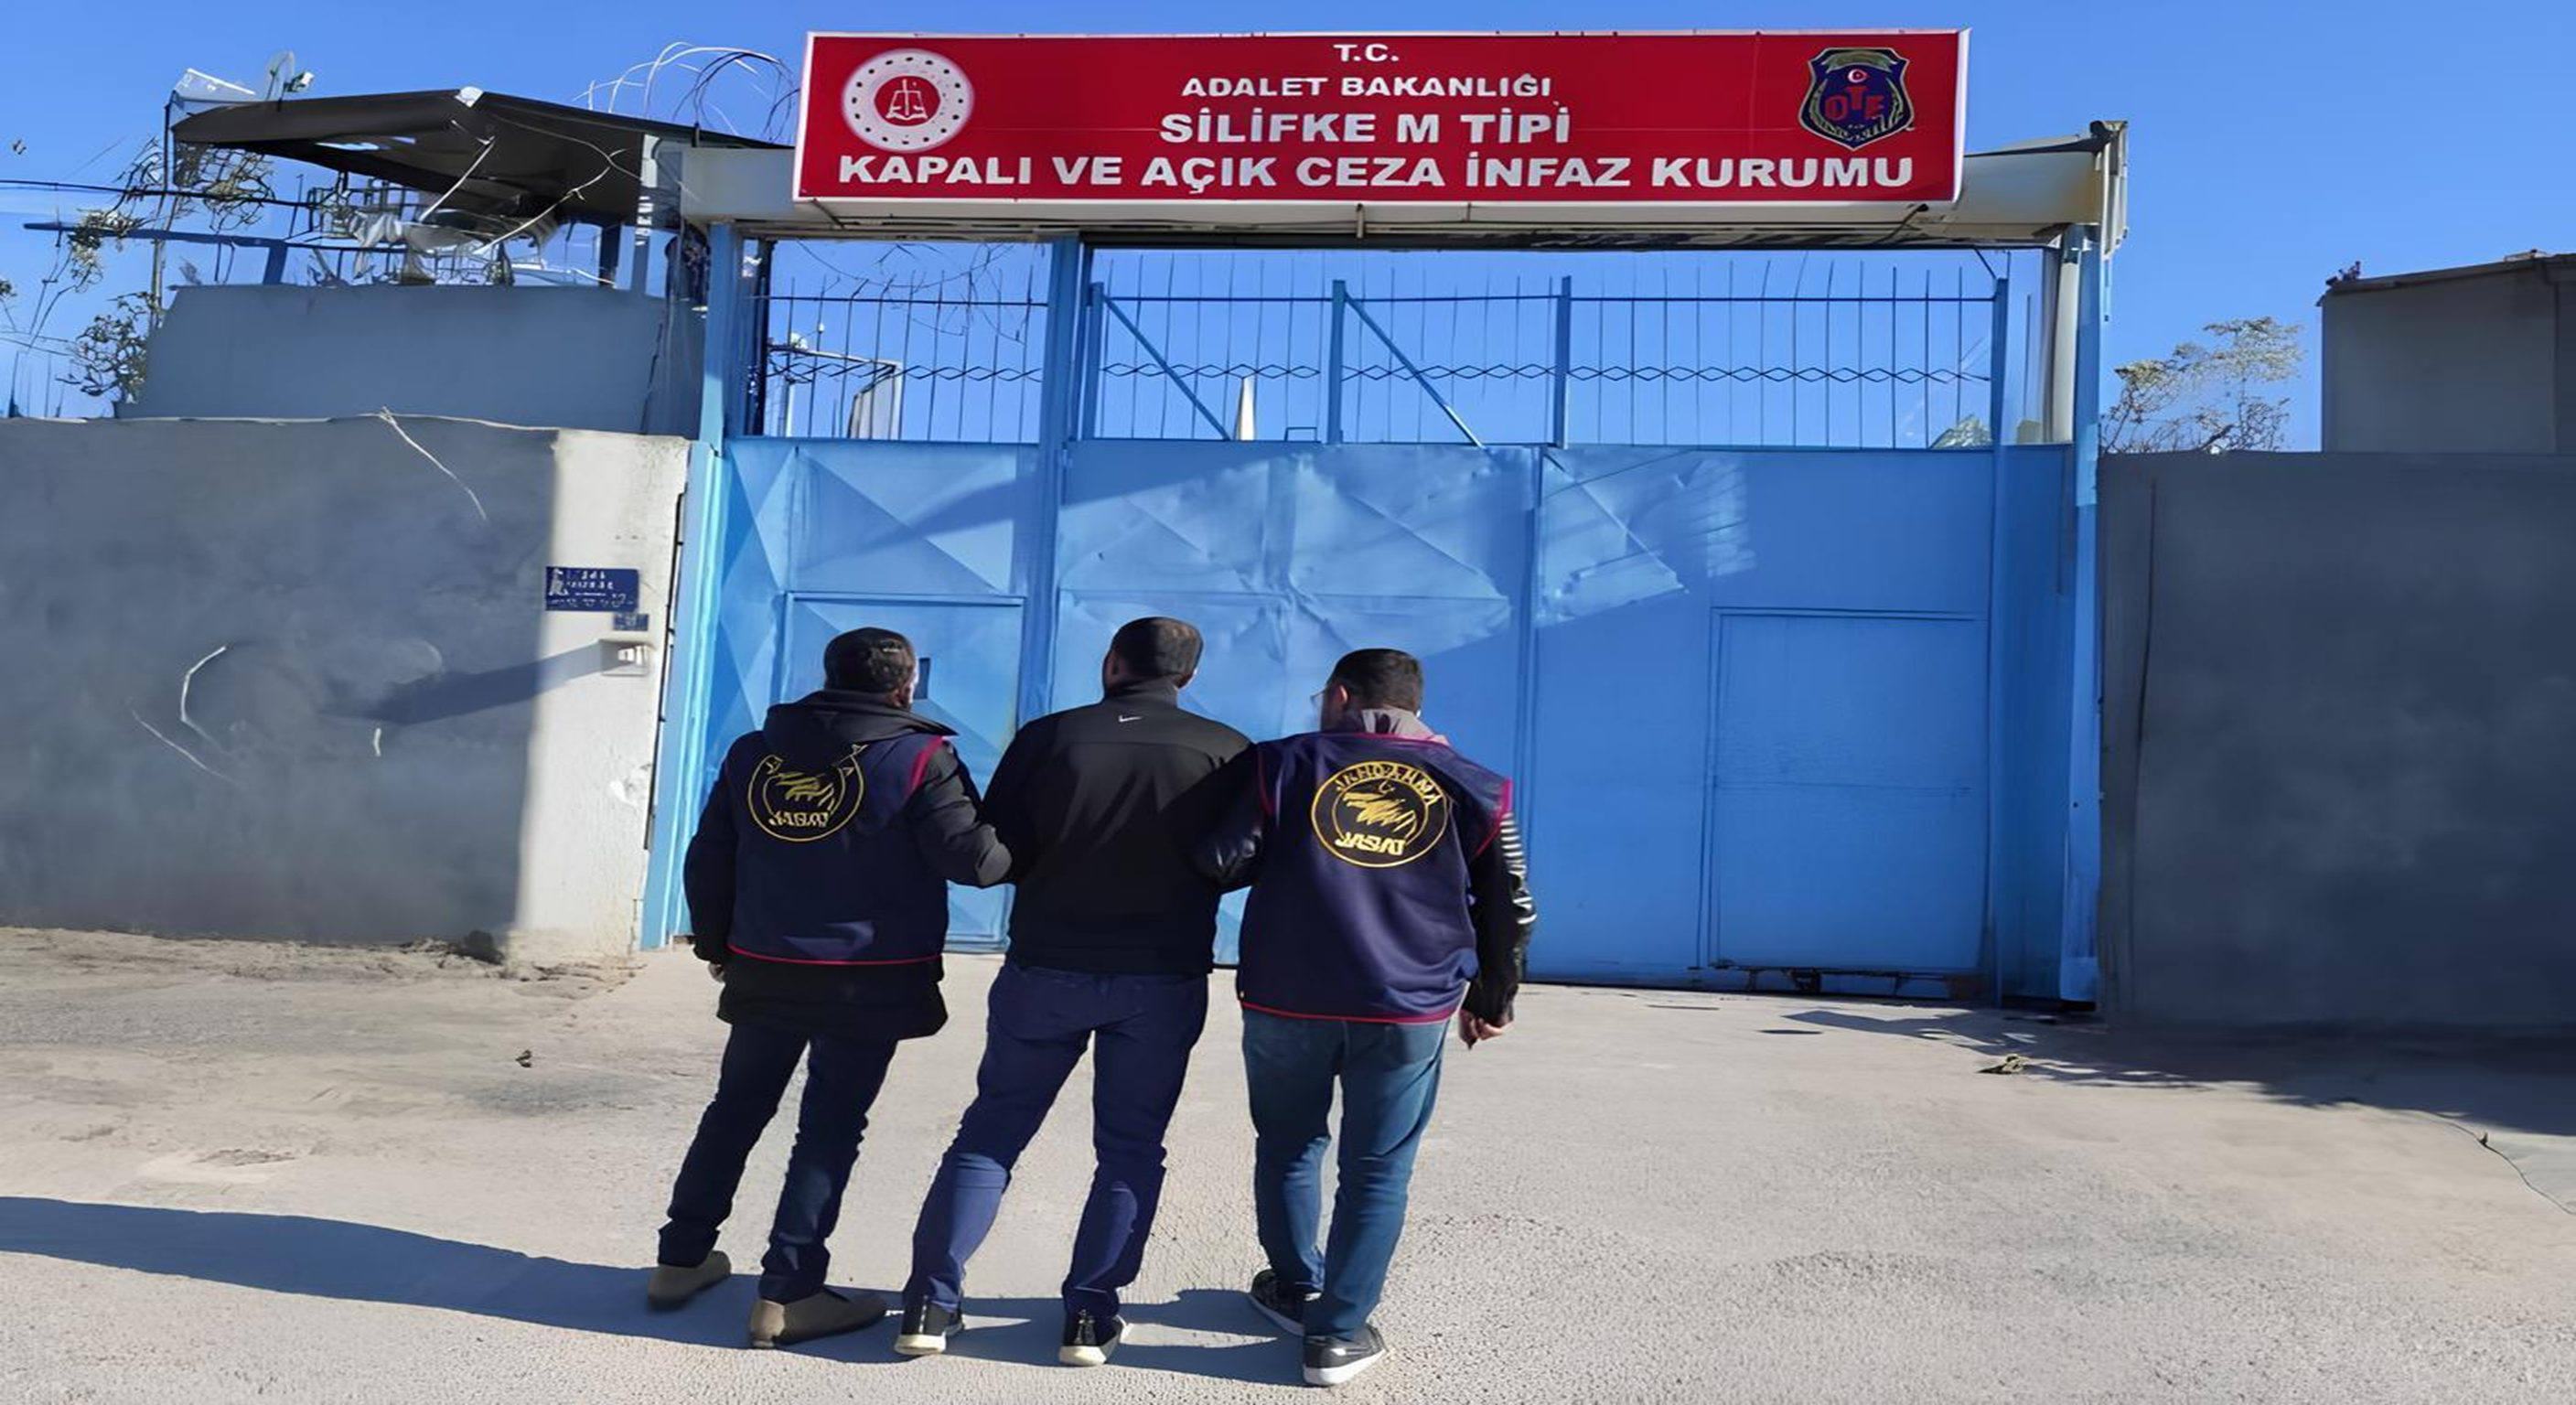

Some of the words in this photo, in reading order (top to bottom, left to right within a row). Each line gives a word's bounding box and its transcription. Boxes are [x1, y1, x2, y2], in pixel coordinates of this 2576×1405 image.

[1332, 43, 1401, 63] T.C.
[1181, 76, 1329, 97] ADALET
[1340, 73, 1551, 97] BAKANLIĞI
[1158, 107, 1377, 144] SİLİFKE
[1396, 113, 1441, 144] M
[1460, 106, 1571, 144] TİPİ
[838, 155, 1032, 185] KAPALI
[1052, 156, 1123, 186] VE
[1141, 156, 1277, 194] AÇIK
[1296, 156, 1446, 188] CEZA
[1465, 151, 1631, 188] İNFAZ
[1651, 156, 1915, 188] KURUMU
